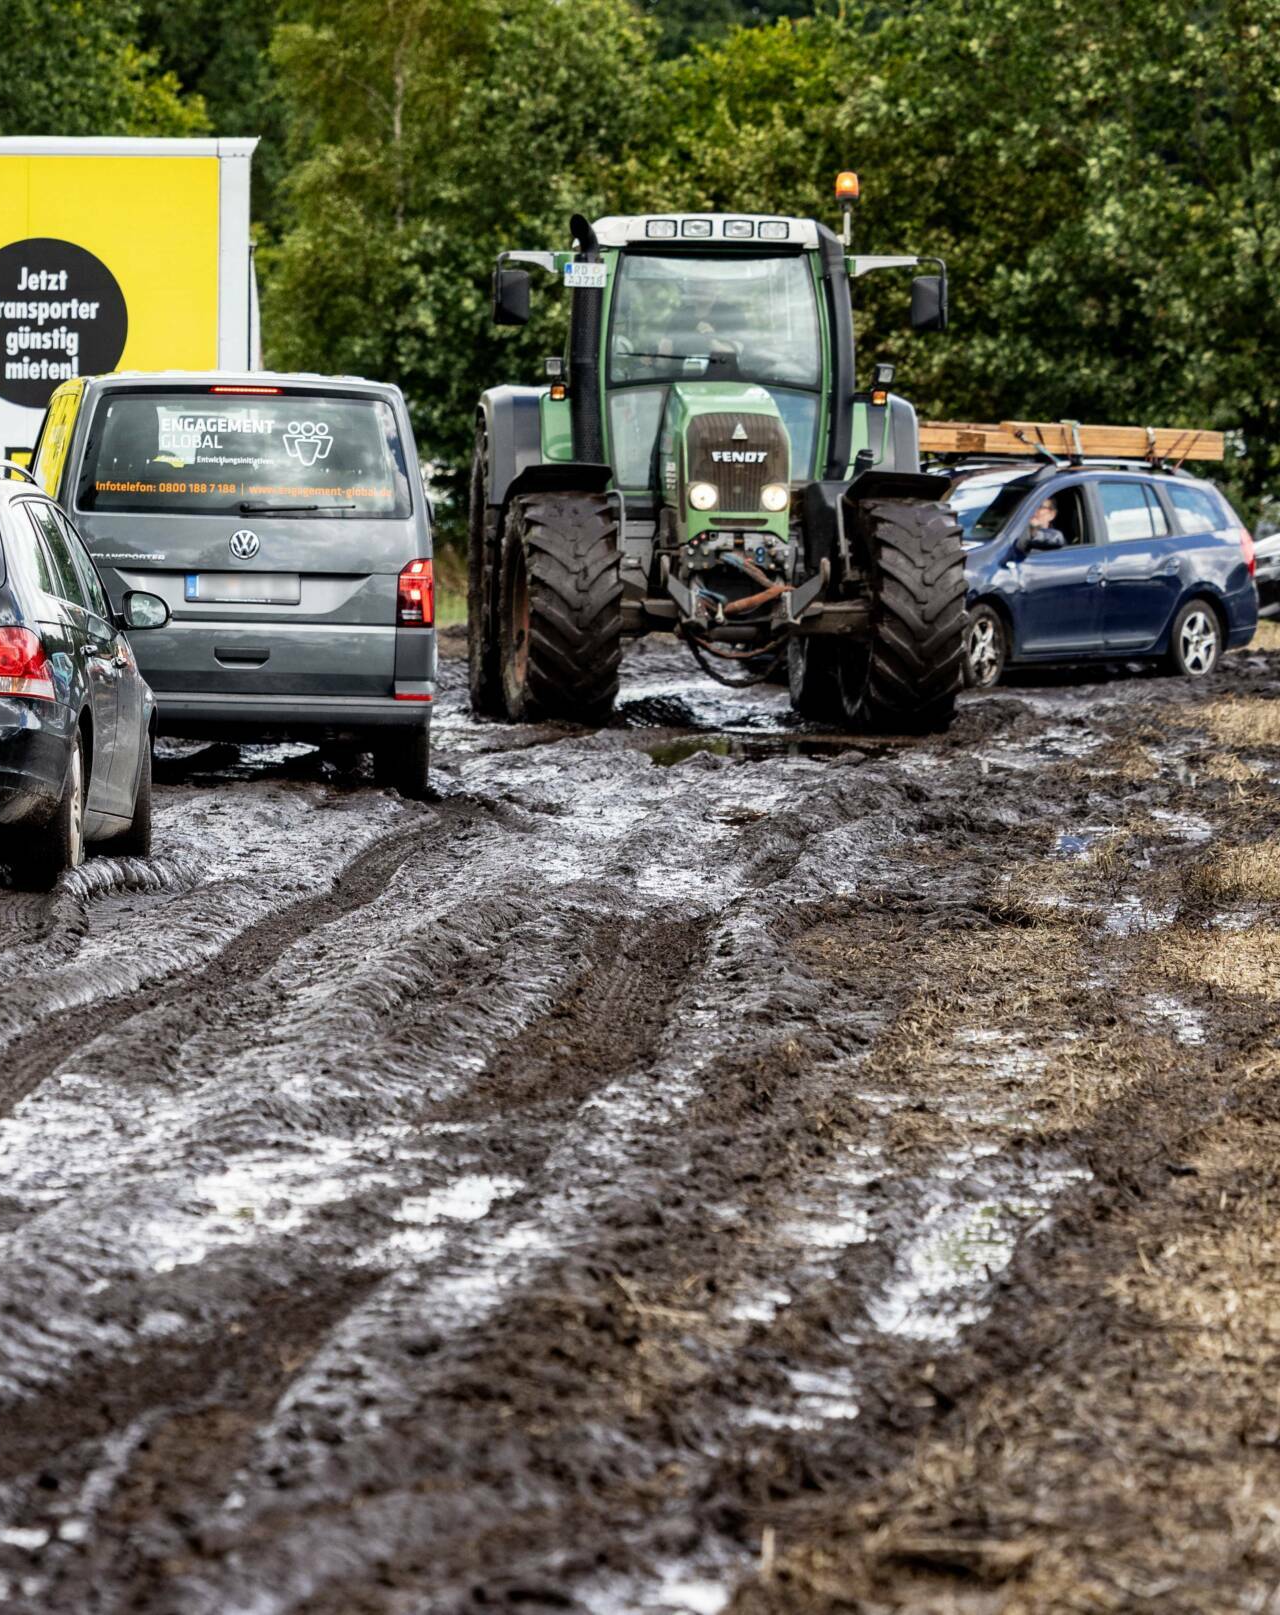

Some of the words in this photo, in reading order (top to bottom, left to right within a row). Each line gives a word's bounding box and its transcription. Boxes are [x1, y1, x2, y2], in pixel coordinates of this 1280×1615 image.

[16, 266, 68, 291] Jetzt
[5, 326, 80, 356] günstig
[5, 356, 80, 380] mieten!
[160, 417, 275, 434] ENGAGEMENT
[160, 434, 223, 449] GLOBAL
[711, 451, 768, 464] FENDT
[95, 480, 157, 493] Infotelefon:
[158, 482, 187, 493] 0800
[189, 483, 207, 494] 188
[209, 483, 216, 494] 7
[217, 483, 237, 494] 188
